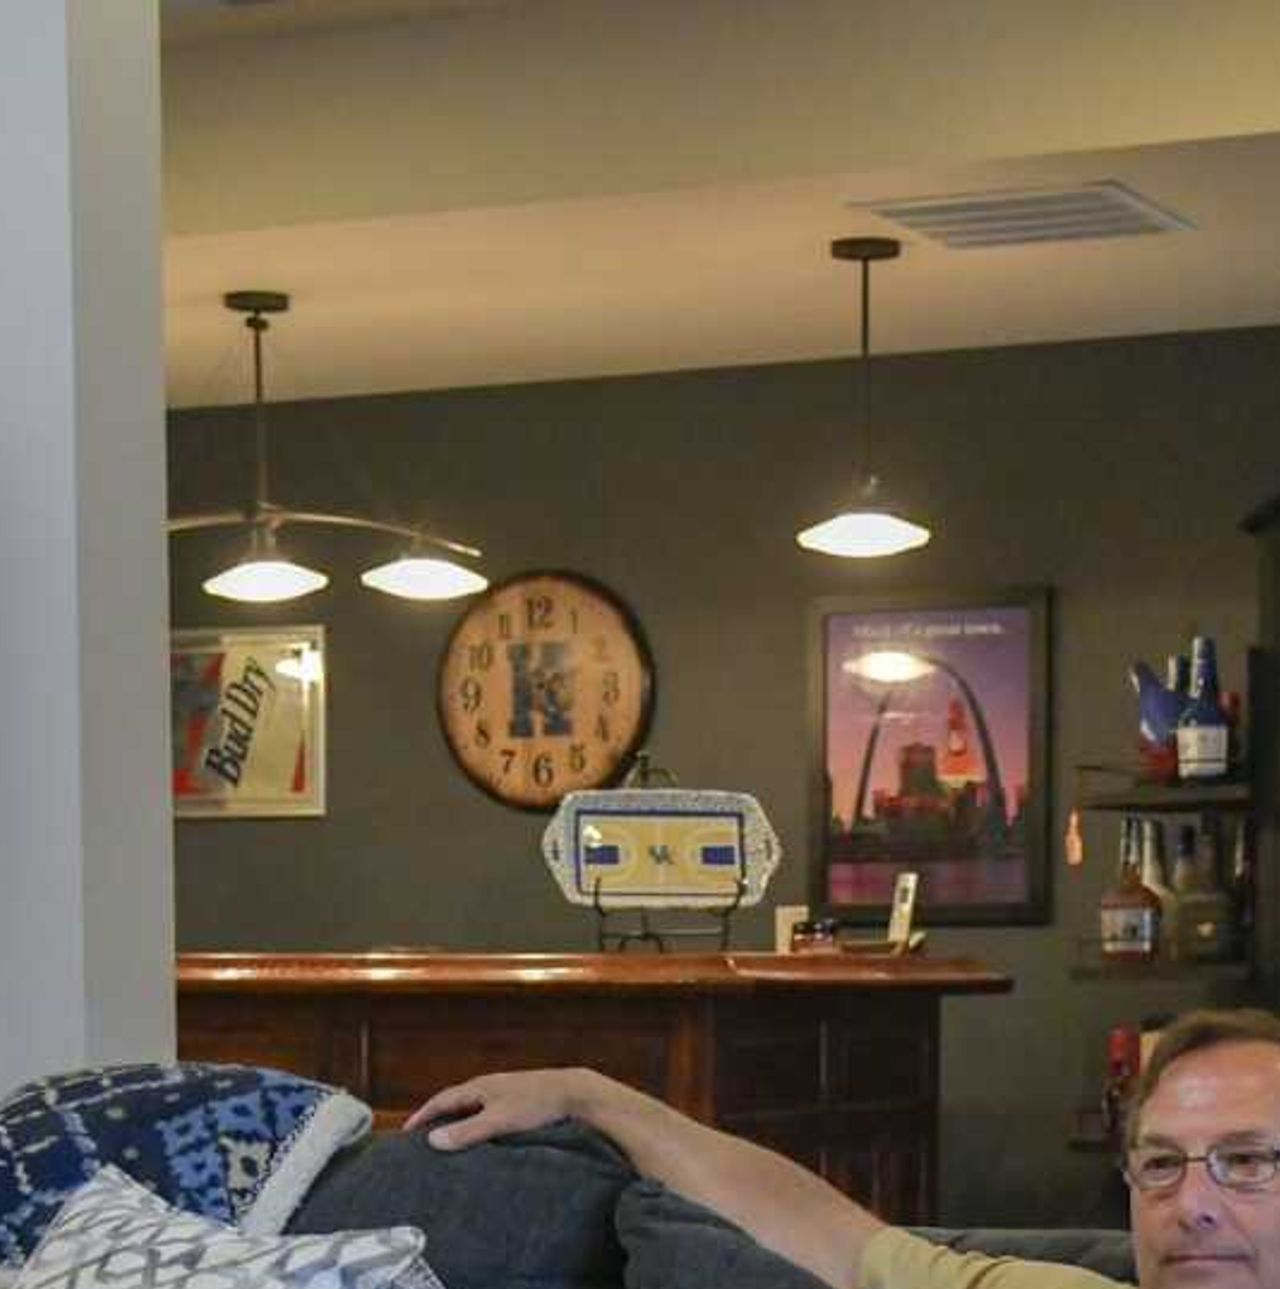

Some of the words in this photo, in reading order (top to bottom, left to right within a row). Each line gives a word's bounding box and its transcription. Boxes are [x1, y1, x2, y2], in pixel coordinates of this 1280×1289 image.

[528, 597, 554, 629] 12
[224, 656, 277, 717] Dry
[461, 677, 482, 711] 9
[205, 705, 254, 786] Bud
[499, 749, 516, 774] 7
[533, 753, 554, 786] 6
